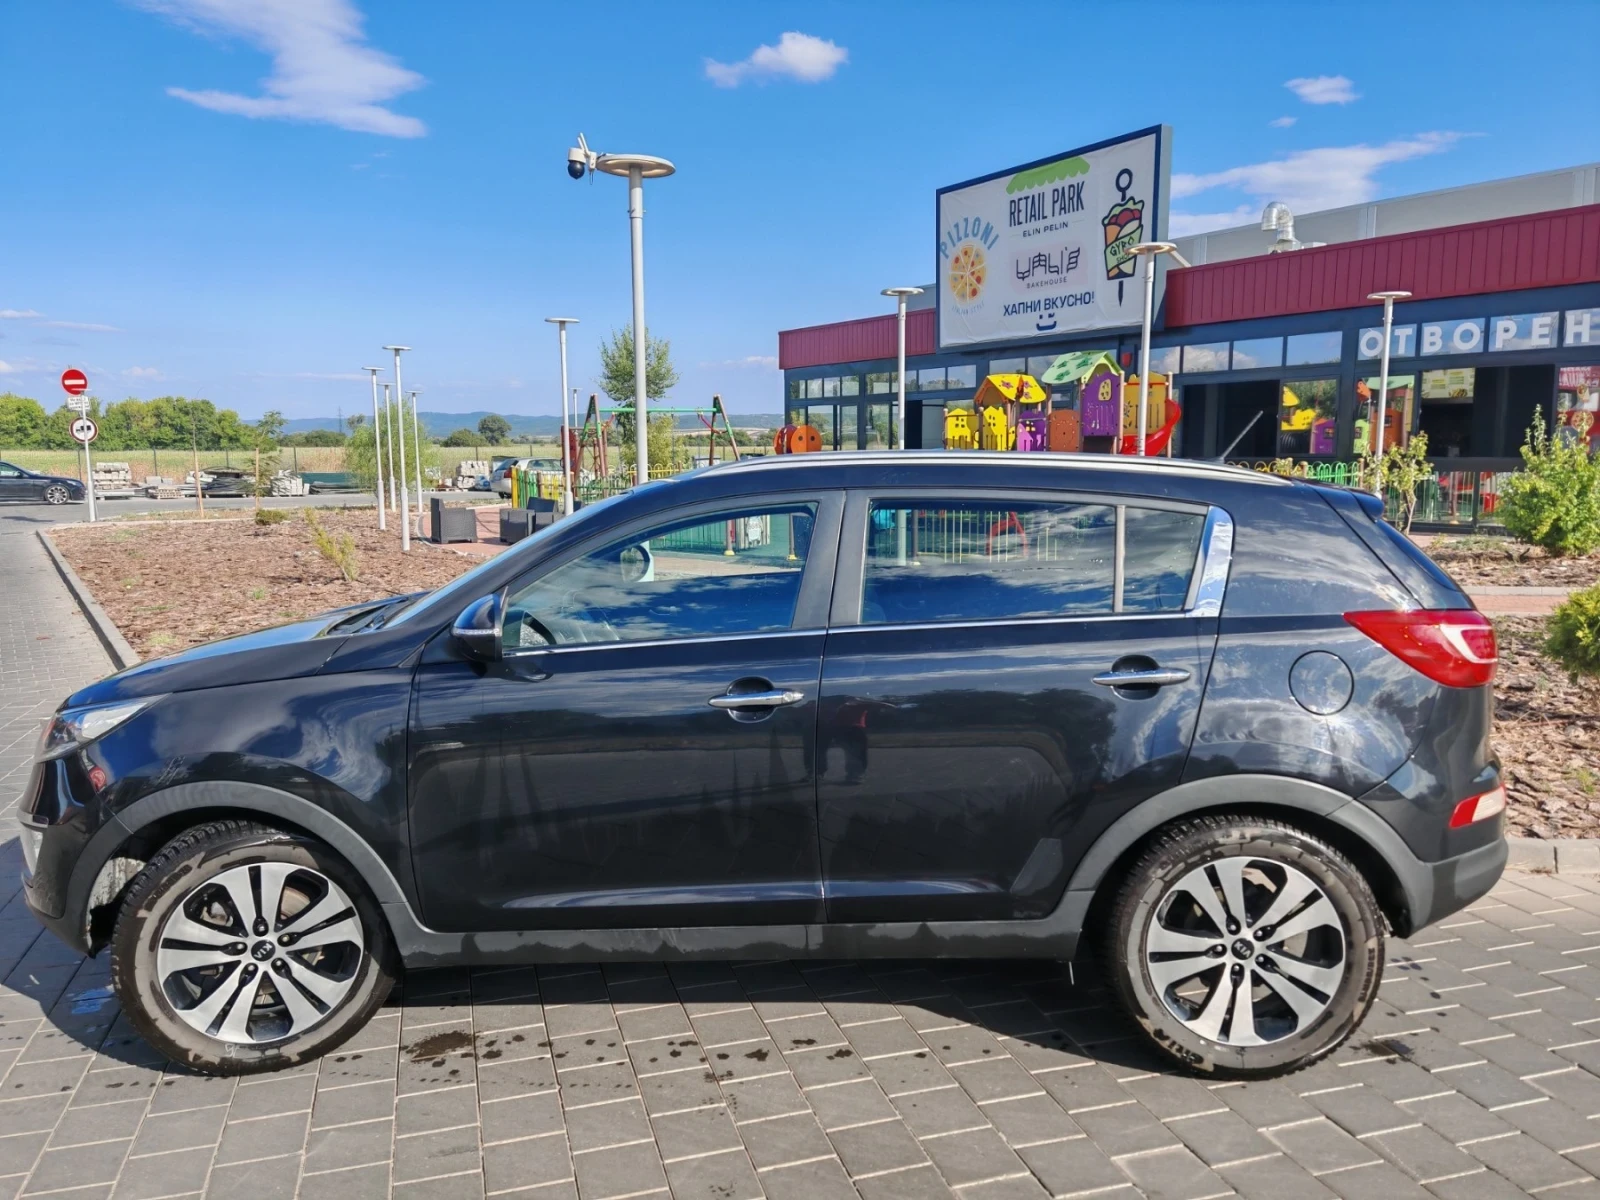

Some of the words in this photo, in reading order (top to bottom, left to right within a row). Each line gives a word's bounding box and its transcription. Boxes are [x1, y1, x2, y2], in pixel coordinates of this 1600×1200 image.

[1009, 192, 1048, 227] RETAIL
[1052, 181, 1085, 217] PARK
[940, 216, 999, 259] PIZZONI
[1022, 228, 1041, 238] ELIN
[1043, 221, 1069, 233] PELIN
[1110, 236, 1135, 256] GYRO
[1026, 276, 1068, 289] BAKEHOUSE
[1003, 299, 1041, 317] ХАПНИ
[1044, 291, 1095, 311] ВКУСНО!
[1360, 313, 1591, 358] ОТВОРЕН
[253, 942, 273, 959] KIA
[1233, 941, 1251, 958] KIA
